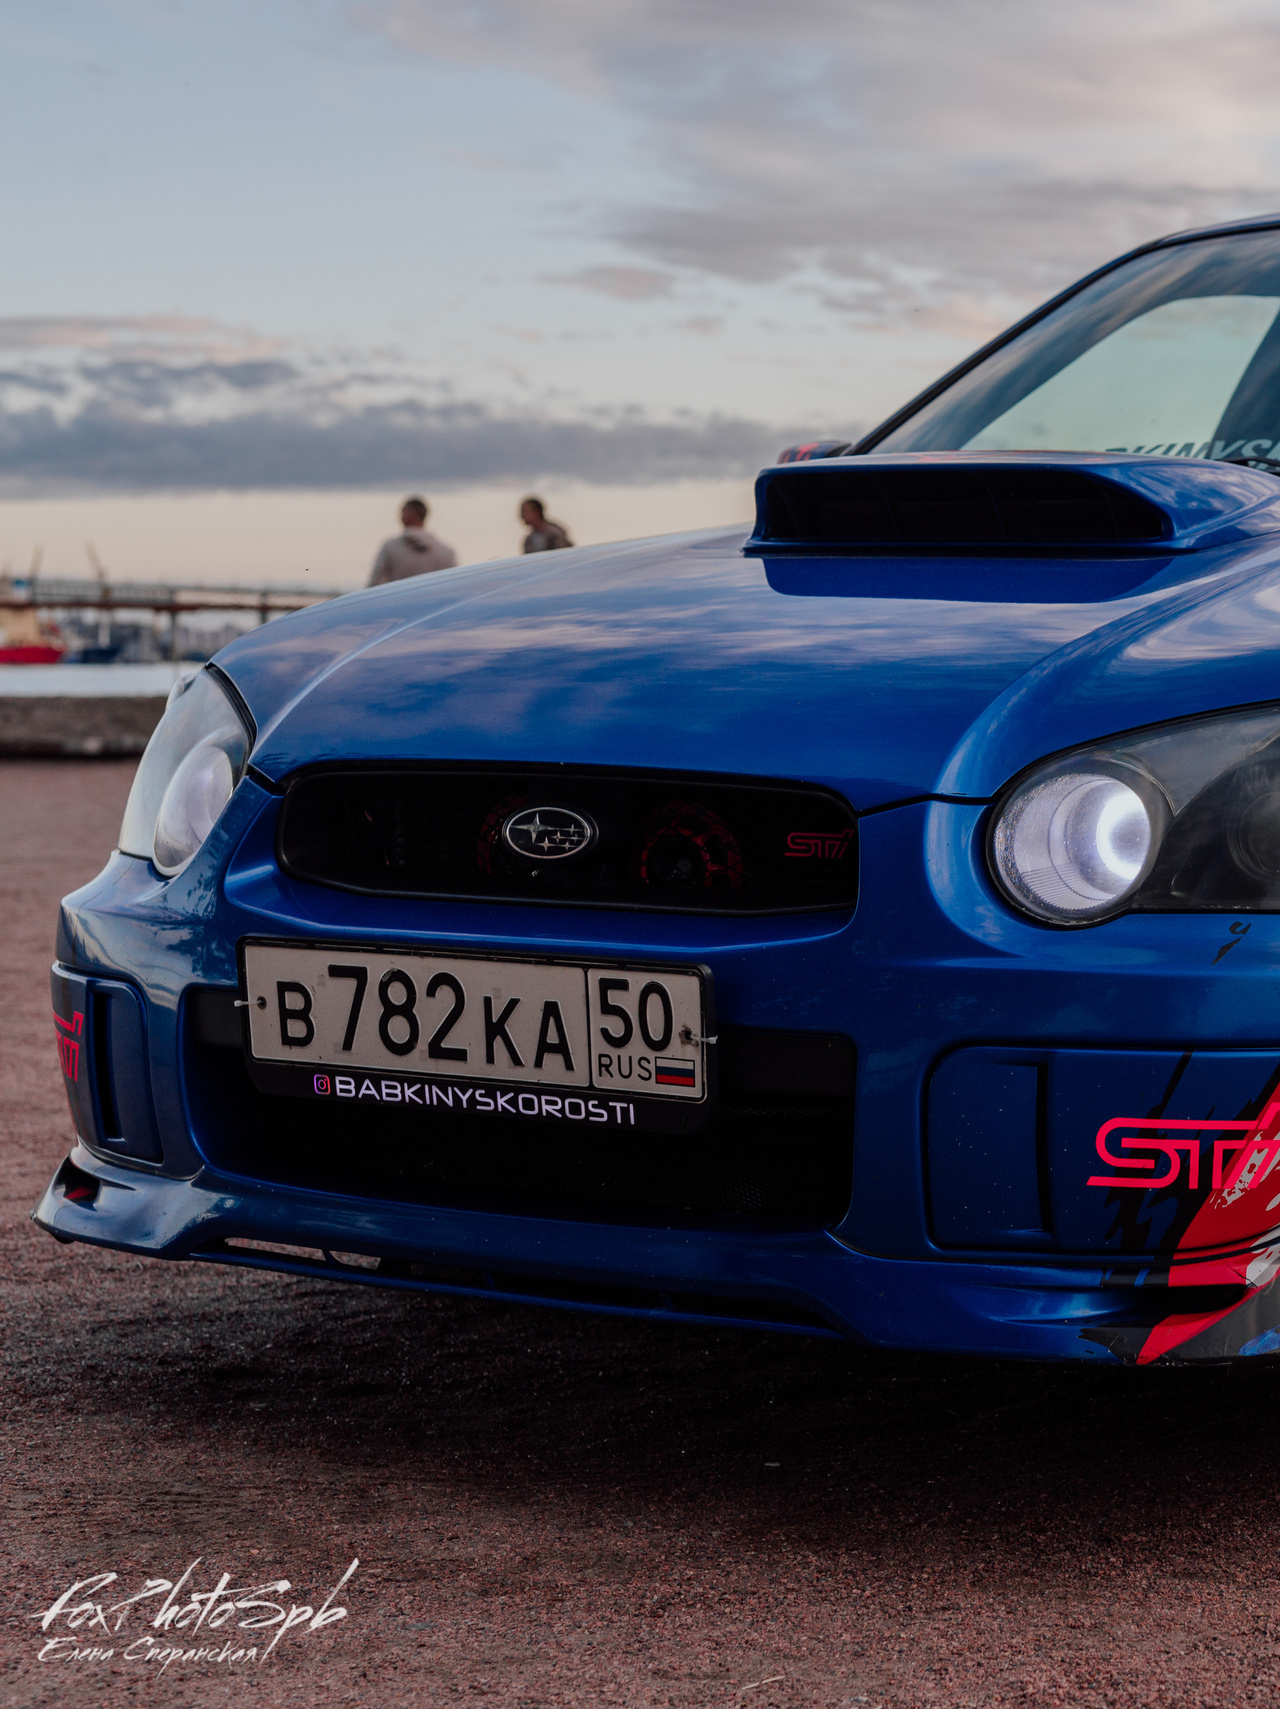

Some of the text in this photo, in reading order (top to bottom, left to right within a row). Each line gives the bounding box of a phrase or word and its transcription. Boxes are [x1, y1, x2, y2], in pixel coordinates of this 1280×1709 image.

[598, 976, 675, 1053] 50
[598, 1052, 653, 1083] RUS
[335, 1075, 637, 1126] BABKINYSKOROSTI
